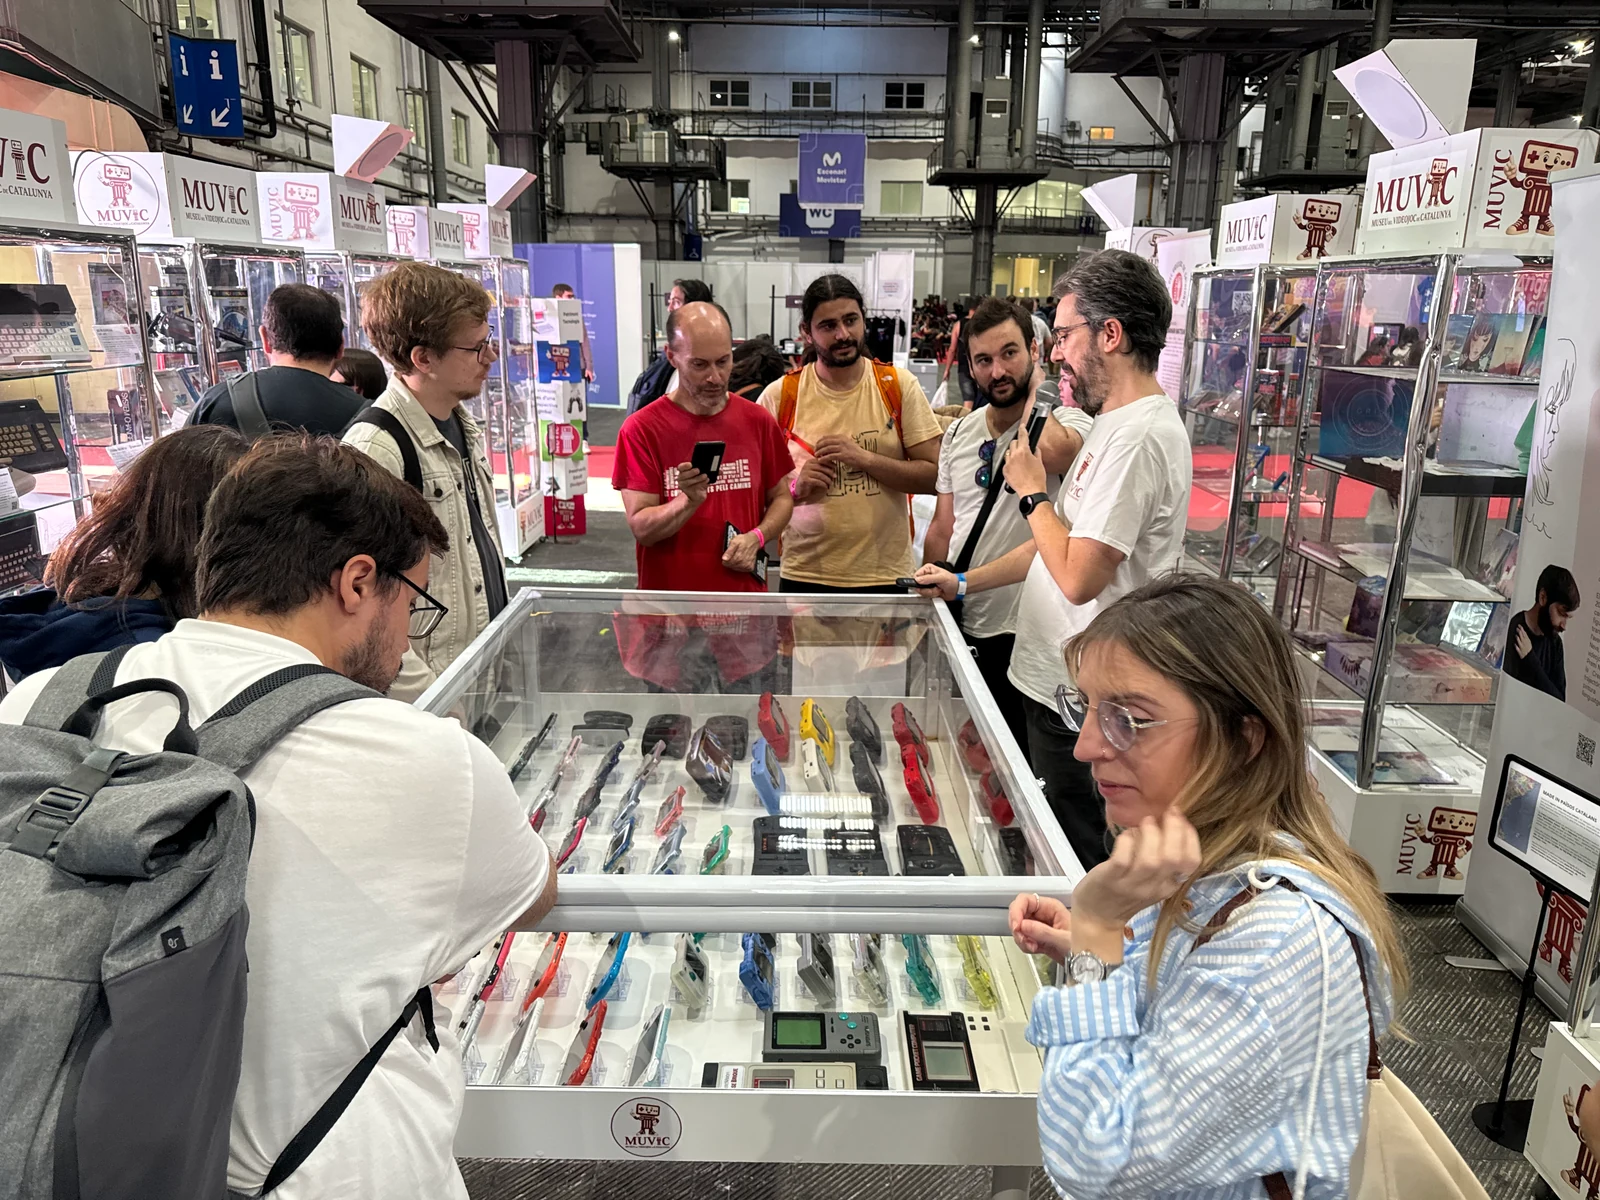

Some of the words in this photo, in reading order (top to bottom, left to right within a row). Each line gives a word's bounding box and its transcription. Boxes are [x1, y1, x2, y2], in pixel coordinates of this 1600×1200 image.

[816, 176, 847, 184] Movistar
[1483, 149, 1513, 230] MUVIC
[8, 185, 54, 199] CATALUNYA
[181, 177, 249, 216] MUVIC
[267, 186, 283, 238] MUVIC
[809, 208, 833, 218] WC
[1420, 210, 1452, 222] CATALUNYA
[1225, 213, 1268, 244] MUVIC
[1542, 790, 1555, 801] MADE
[1555, 796, 1561, 804] IN
[1575, 806, 1598, 823] CATALANS
[1396, 813, 1422, 875] MUVIC
[908, 1023, 918, 1048] COMPUTER
[911, 1048, 920, 1066] POCKET
[913, 1066, 923, 1082] GAME
[625, 1136, 671, 1146] MUVIC
